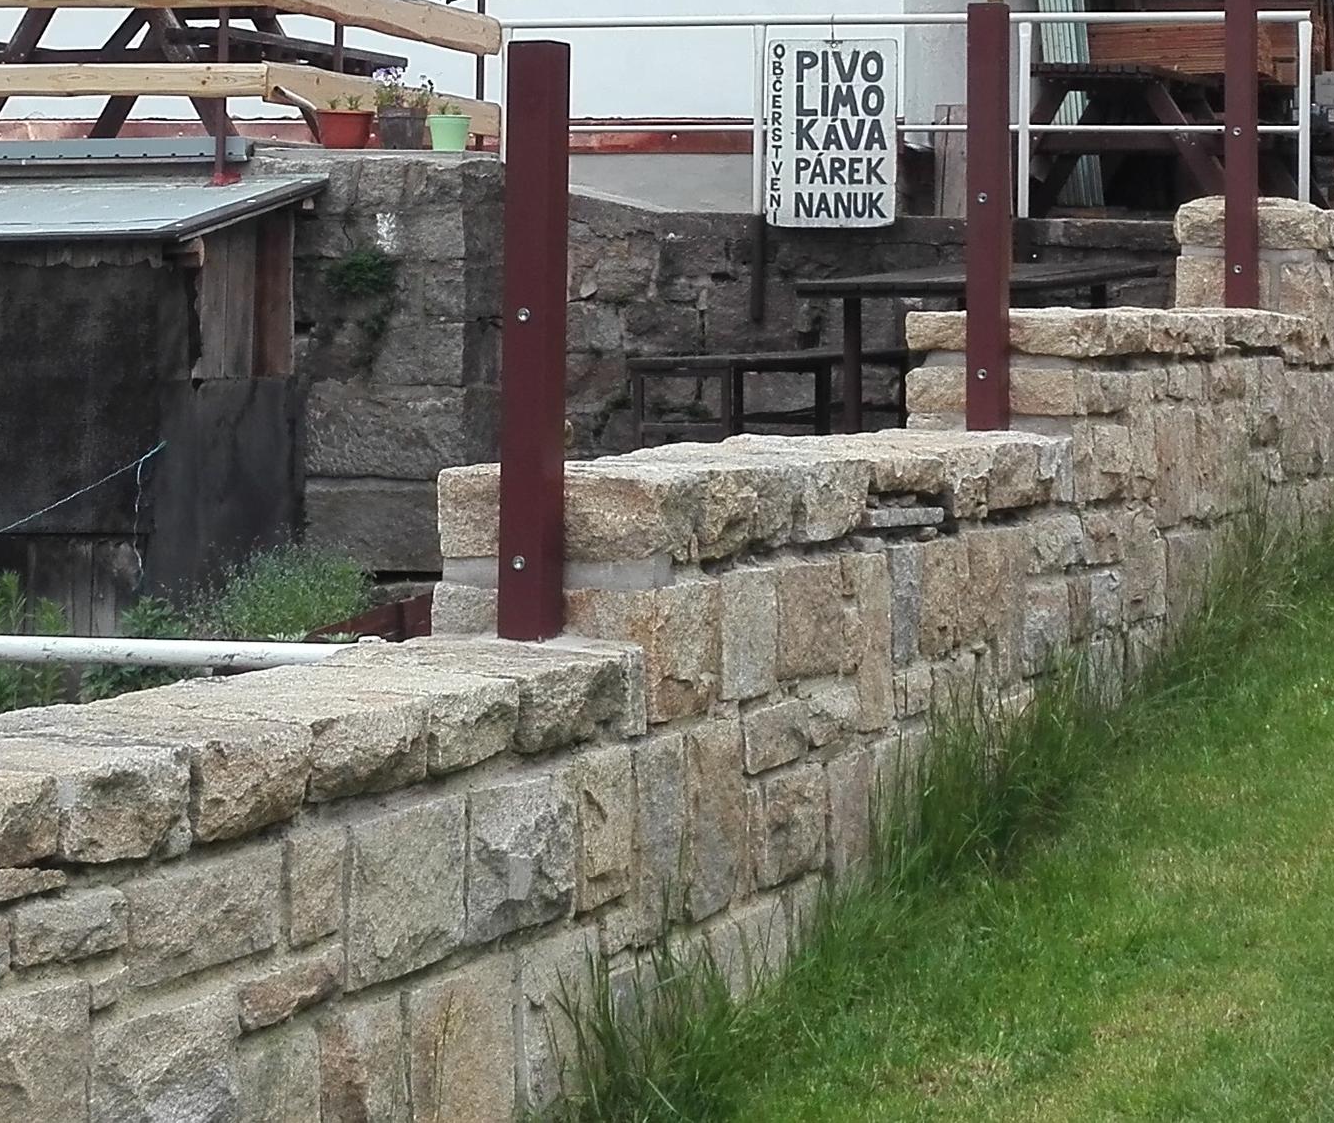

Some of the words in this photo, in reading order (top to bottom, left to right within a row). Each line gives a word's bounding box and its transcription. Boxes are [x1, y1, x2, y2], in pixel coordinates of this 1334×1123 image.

[796, 50, 884, 83] PIVO
[796, 84, 885, 117] LIMO
[795, 117, 887, 150] KÁVA
[795, 152, 887, 185] PÁREK
[794, 191, 887, 219] NANUK
